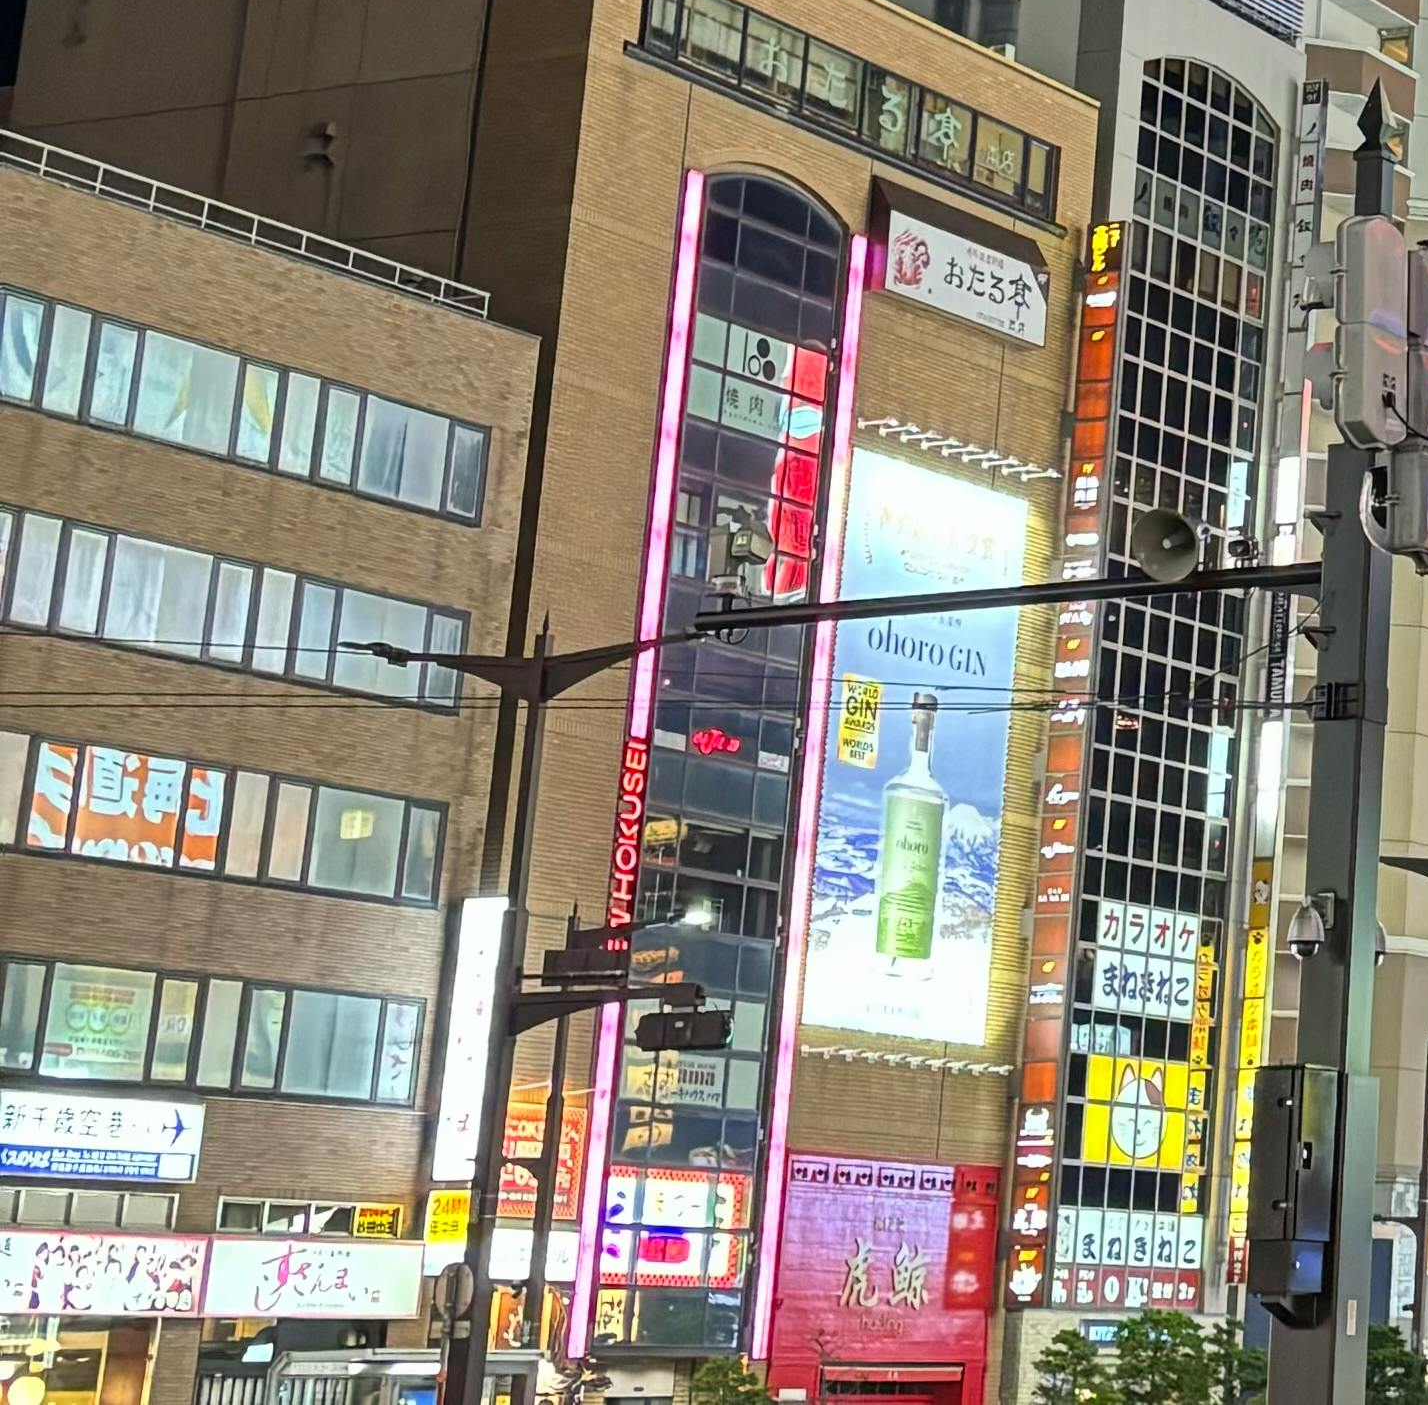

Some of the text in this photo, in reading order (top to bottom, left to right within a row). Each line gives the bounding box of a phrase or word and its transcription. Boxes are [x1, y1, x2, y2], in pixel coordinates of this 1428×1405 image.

[867, 619, 986, 677] ohoro GIN
[846, 695, 877, 720] GIN
[611, 741, 648, 900] HOKUSEI
[1103, 909, 1194, 952] カラオケ
[1102, 962, 1189, 1007] まねきねこ
[1083, 1232, 1196, 1264] まねきねこ
